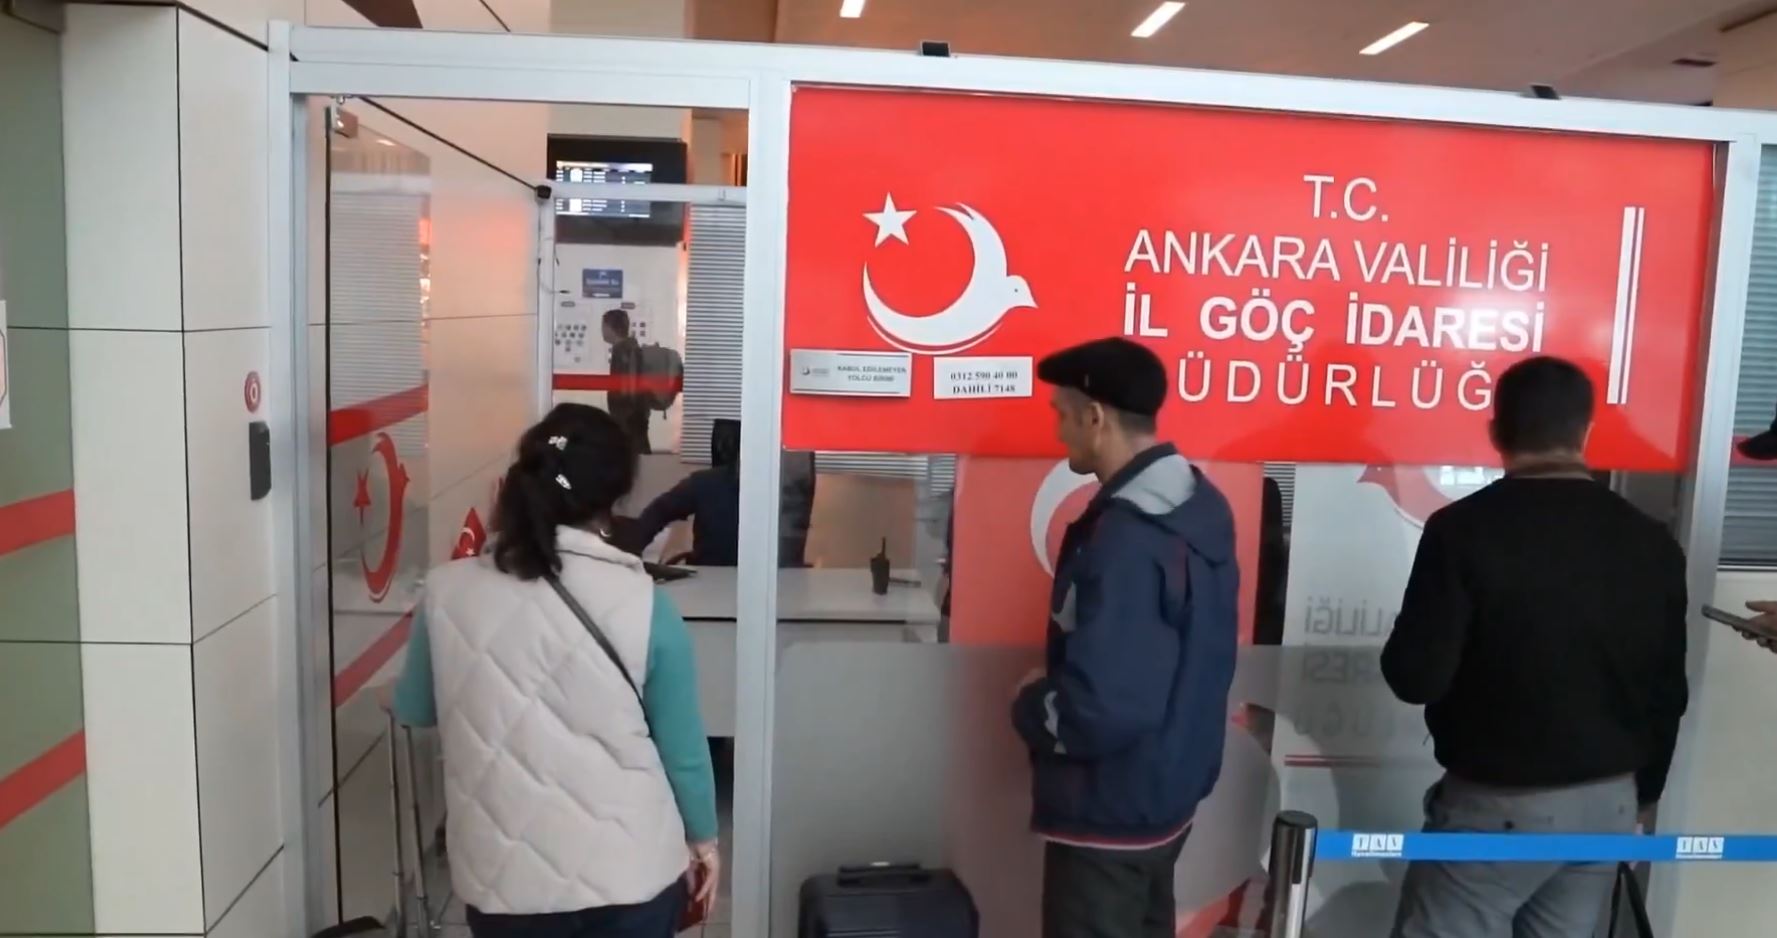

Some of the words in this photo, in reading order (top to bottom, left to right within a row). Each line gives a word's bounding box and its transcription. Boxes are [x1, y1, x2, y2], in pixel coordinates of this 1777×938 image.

[1303, 174, 1389, 222] T.C.
[1124, 229, 1341, 281] ANKARA
[1353, 236, 1549, 292] VALİLİĞİ
[1123, 282, 1169, 338] İL
[1199, 287, 1316, 354] GÖÇ
[1345, 291, 1545, 353] İDARESİ
[950, 371, 973, 381] 0312
[1177, 350, 1493, 411] ÜDÜRLÜĞ
